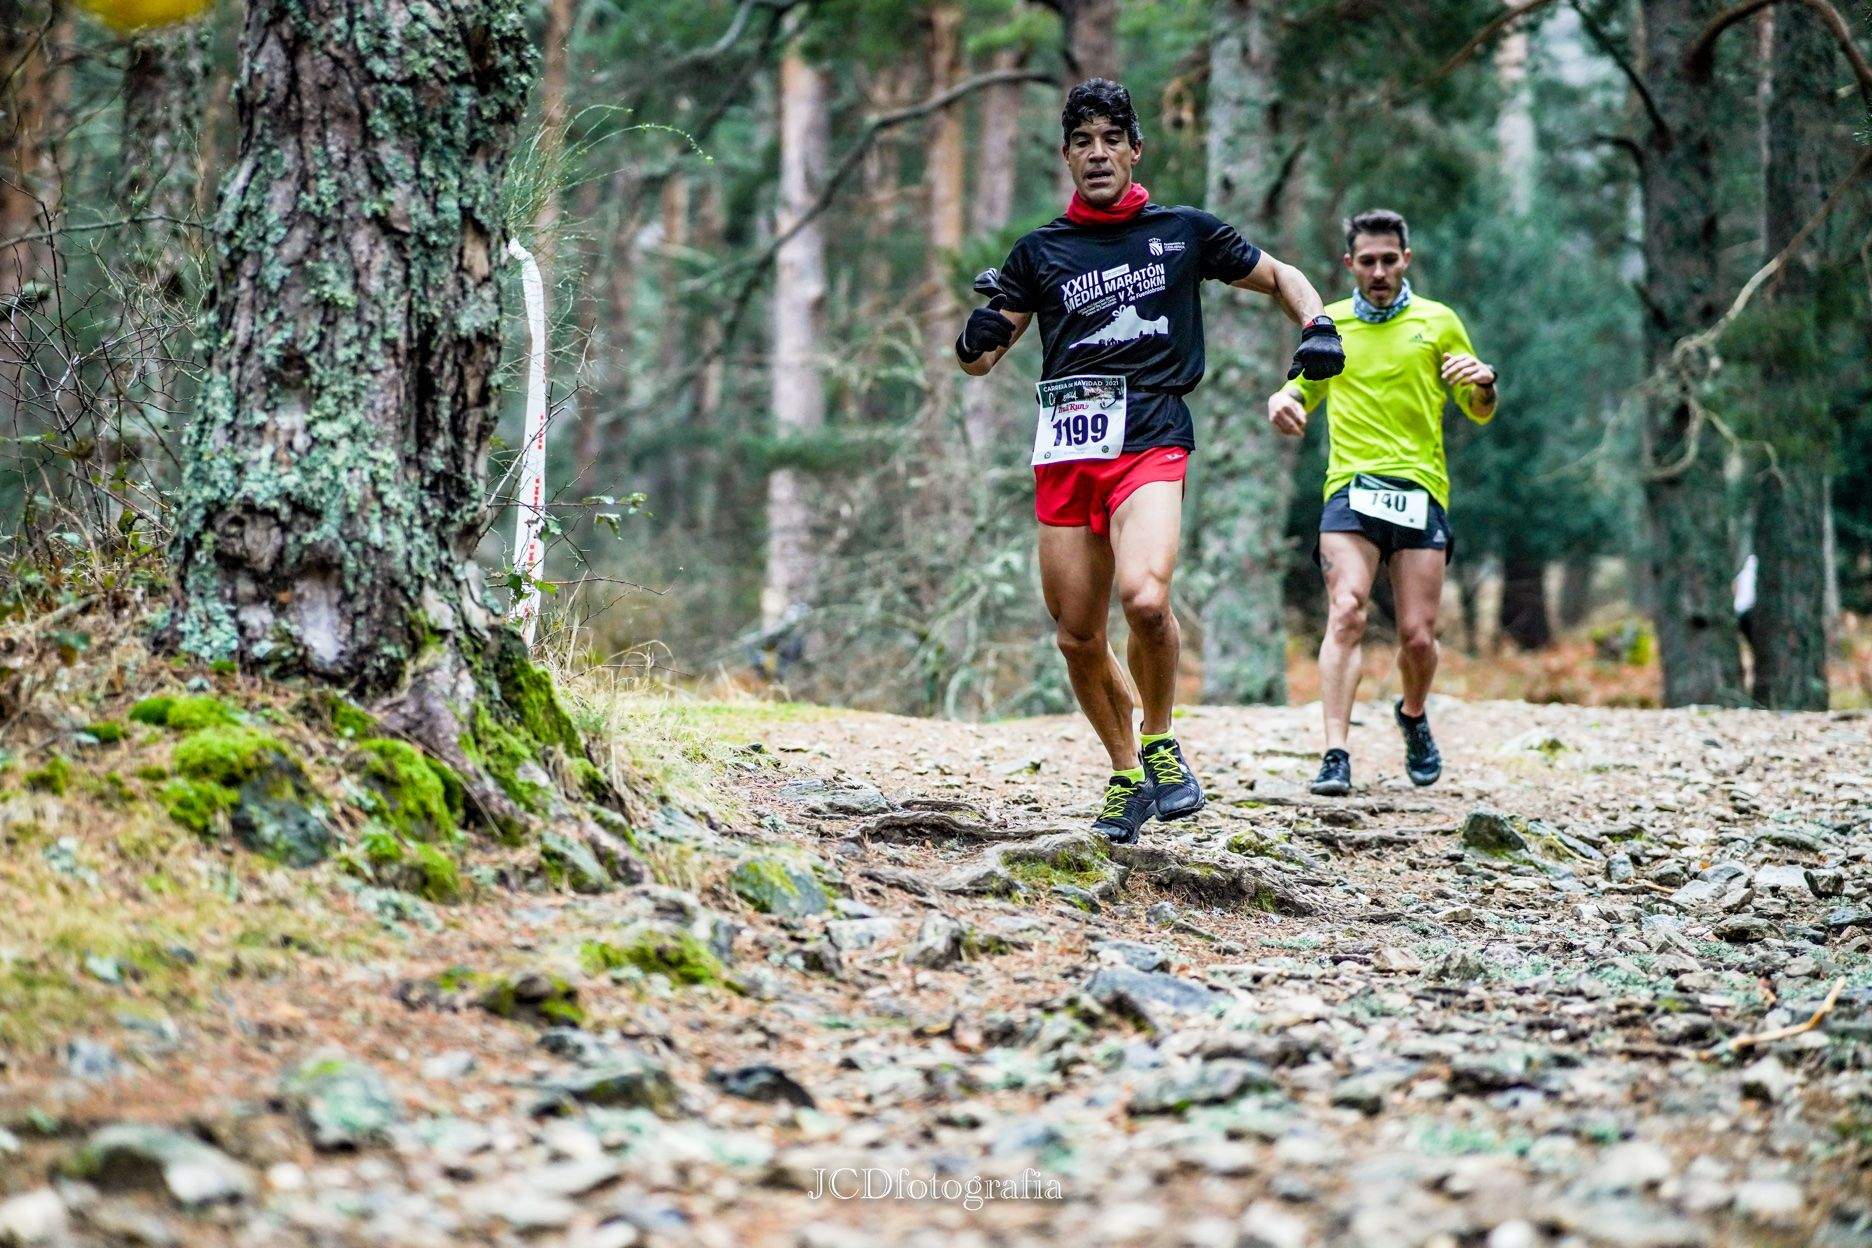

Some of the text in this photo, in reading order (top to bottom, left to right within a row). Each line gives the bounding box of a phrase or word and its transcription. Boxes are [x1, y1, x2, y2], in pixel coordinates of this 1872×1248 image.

[1061, 270, 1099, 300] XXIII
[1064, 285, 1103, 314] MEDIA
[1104, 263, 1166, 294] MARATÓN
[1127, 286, 1135, 297] X
[1137, 275, 1166, 293] 10KM
[1052, 413, 1109, 447] 1199
